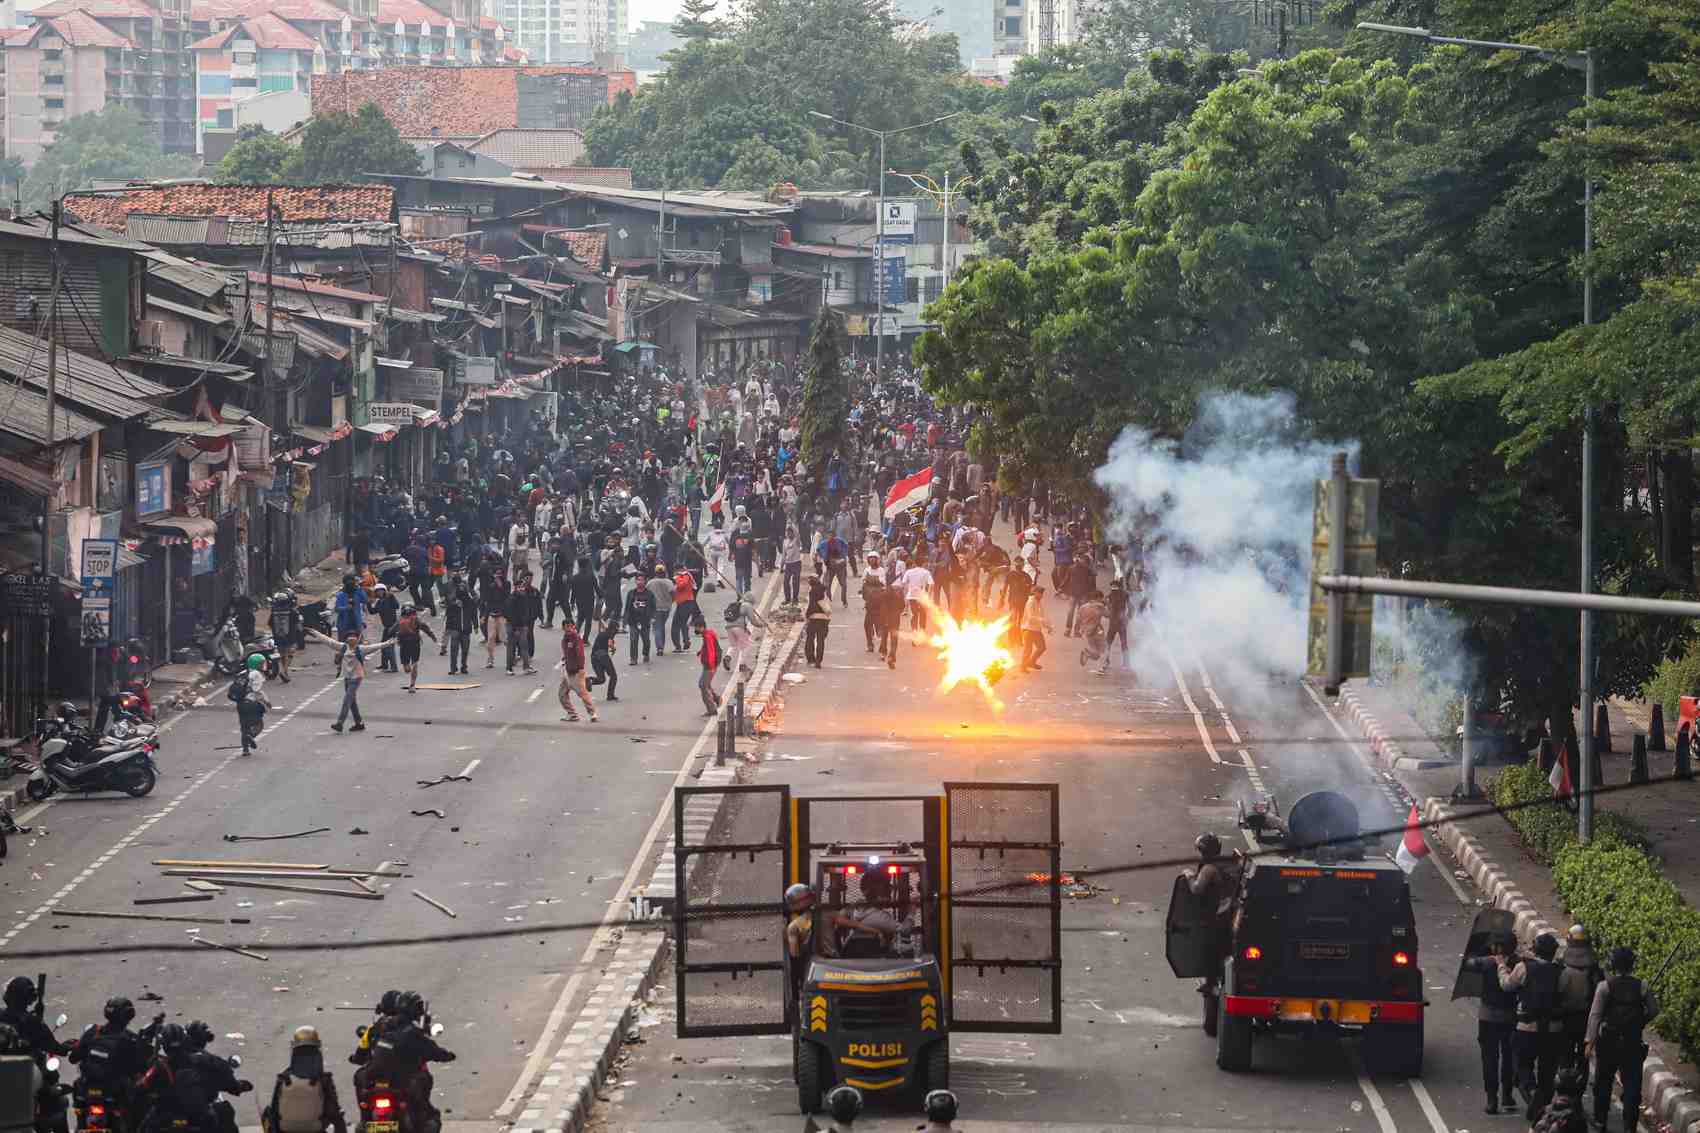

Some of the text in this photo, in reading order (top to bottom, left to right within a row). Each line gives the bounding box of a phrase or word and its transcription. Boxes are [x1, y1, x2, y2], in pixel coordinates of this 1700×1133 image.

[371, 407, 410, 417] STEMPEL
[87, 559, 110, 574] STOP
[848, 1043, 902, 1057] POLISI
